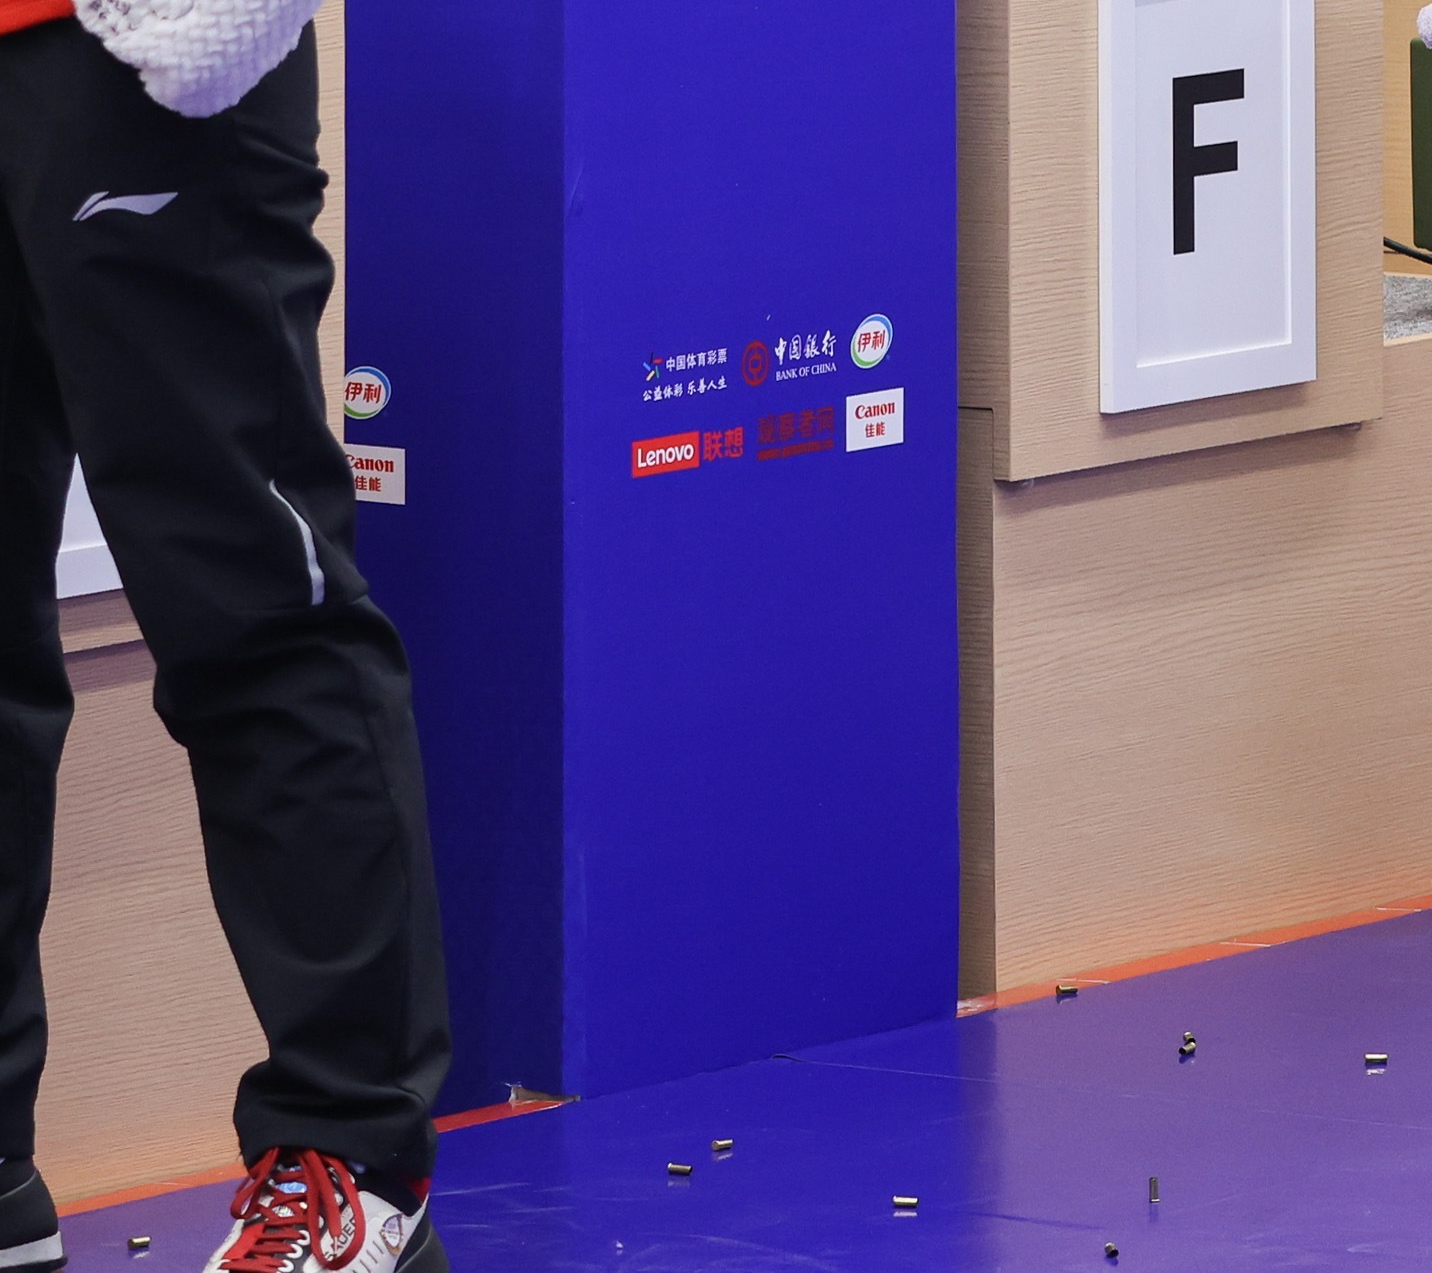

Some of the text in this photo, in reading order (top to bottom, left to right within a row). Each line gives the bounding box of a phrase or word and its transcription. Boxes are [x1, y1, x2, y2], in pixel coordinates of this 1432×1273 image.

[1172, 68, 1244, 255] F
[774, 329, 838, 366] 中国银行
[857, 329, 886, 354] 伊利
[665, 347, 728, 373] 中国体育彩票
[775, 361, 837, 382] BANK OF CHINA
[345, 381, 382, 404] 伊利
[854, 401, 896, 420] Canon
[865, 422, 886, 438] 佳能
[637, 442, 694, 468] Lenovo
[703, 426, 744, 461] 联想
[345, 454, 395, 473] Canon
[354, 475, 382, 492] 佳能
